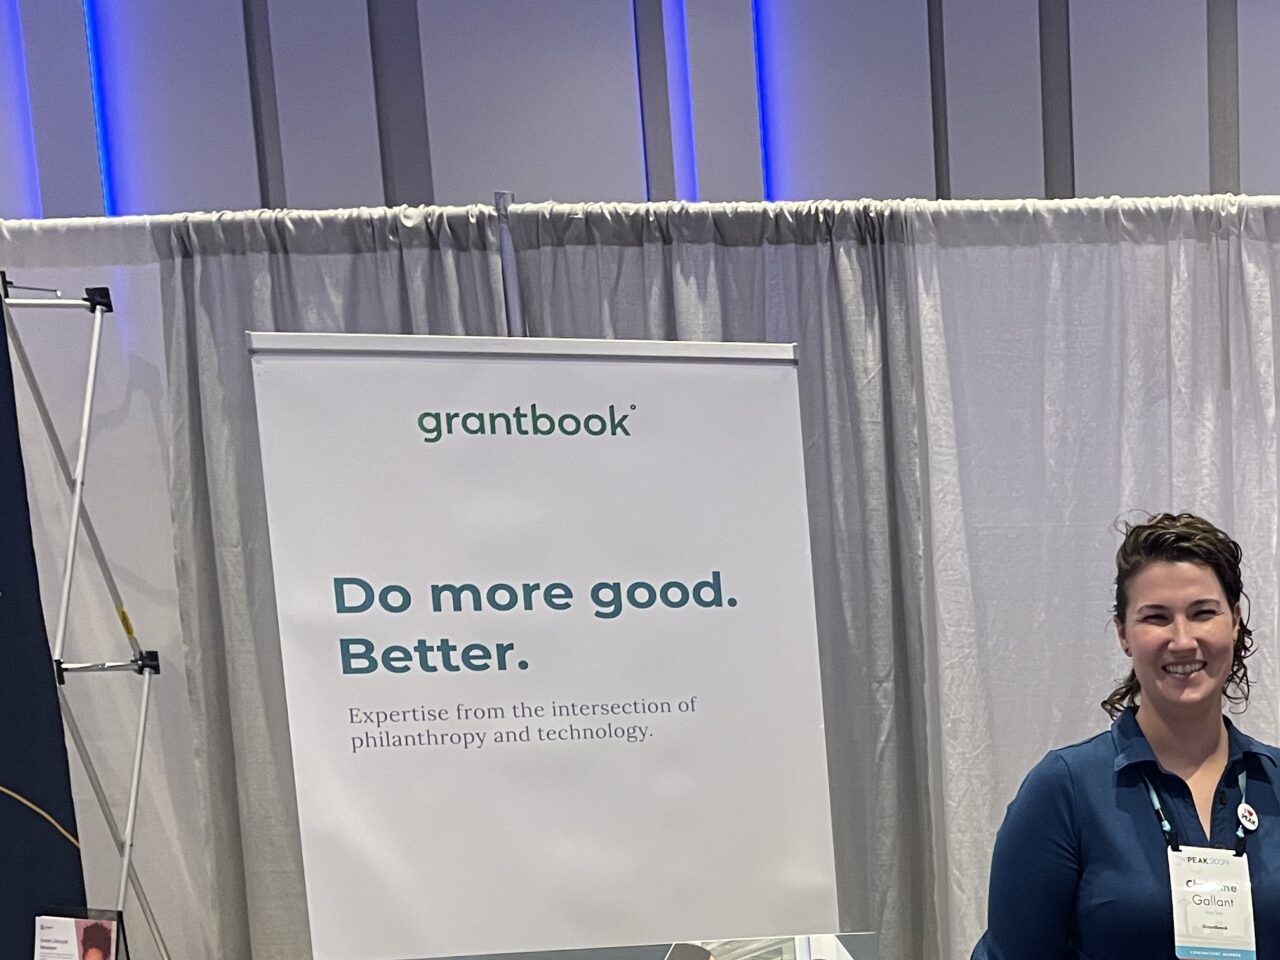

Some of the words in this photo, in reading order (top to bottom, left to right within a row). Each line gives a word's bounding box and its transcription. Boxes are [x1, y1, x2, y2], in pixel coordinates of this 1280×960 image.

[333, 576, 411, 614] Do
[431, 578, 574, 612] more
[590, 570, 739, 619] good.
[339, 636, 530, 675] Better.
[349, 706, 449, 728] Expertise
[456, 703, 505, 722] from
[512, 701, 545, 720] the
[551, 697, 671, 718] intersection
[677, 695, 698, 714] of
[351, 728, 487, 753] philanthropy
[493, 724, 530, 744] and
[537, 720, 654, 744] technology.
[1192, 894, 1234, 908] Gallant
